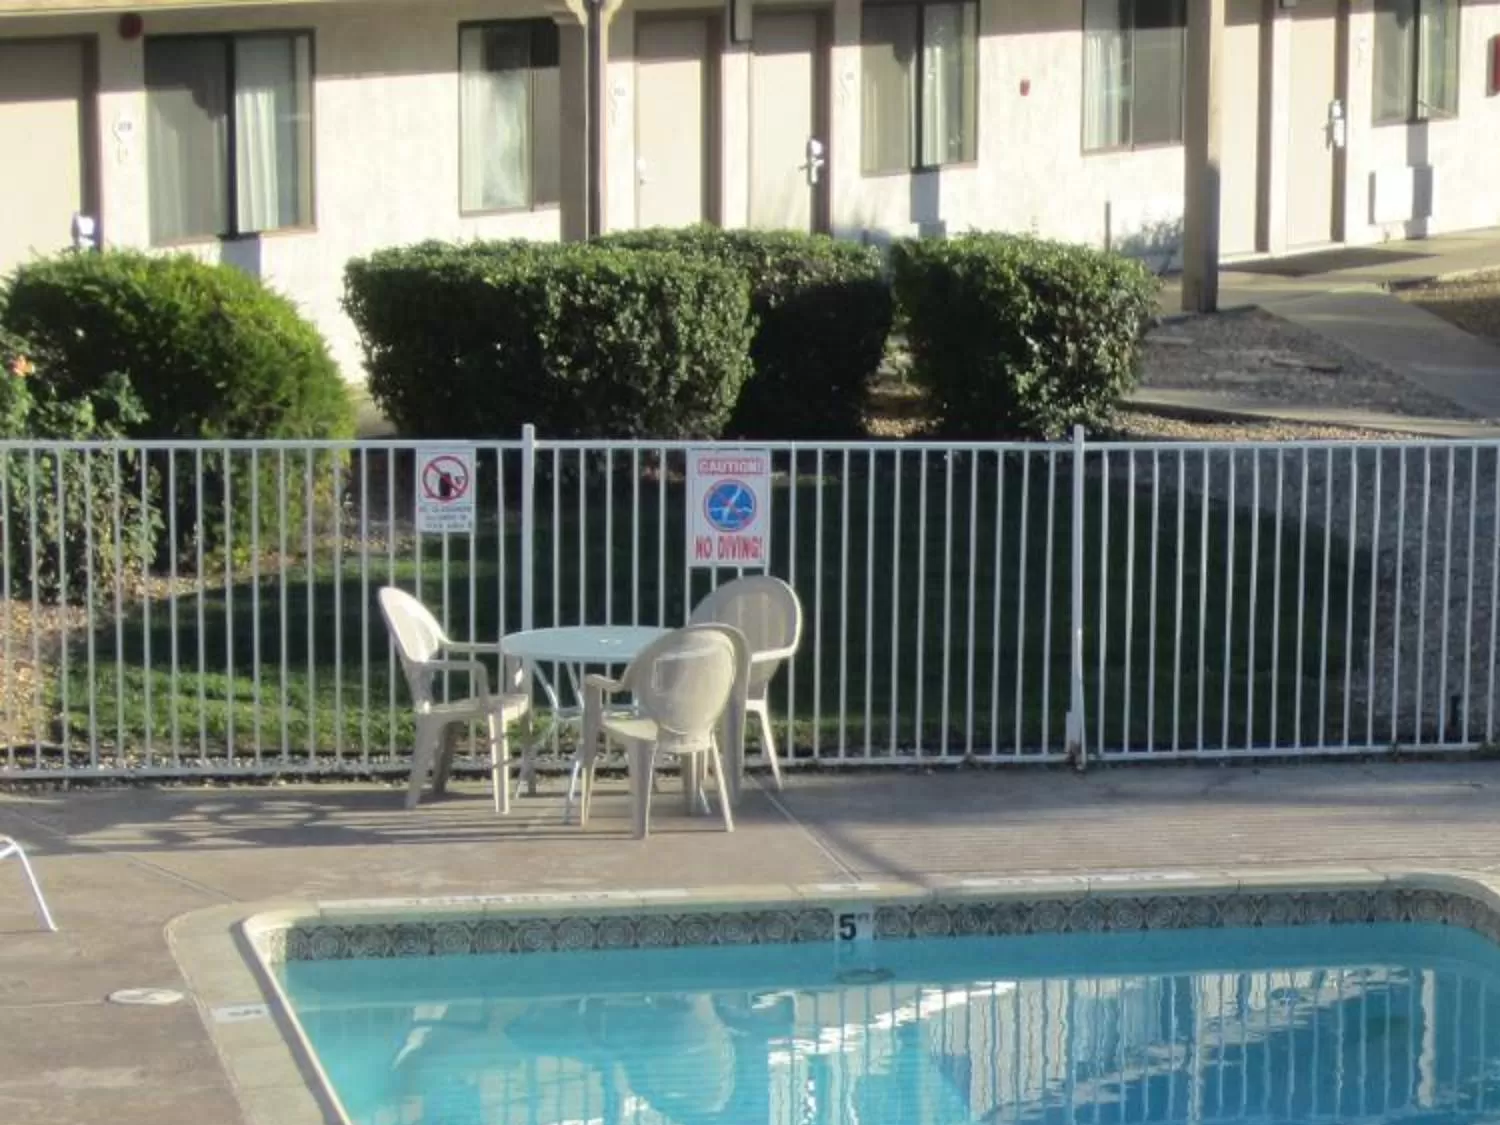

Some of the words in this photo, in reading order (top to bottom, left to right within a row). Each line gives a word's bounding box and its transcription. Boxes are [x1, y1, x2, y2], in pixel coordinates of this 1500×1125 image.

[695, 535, 713, 560] NO
[717, 535, 764, 561] DIVING!
[839, 912, 858, 942] 5
